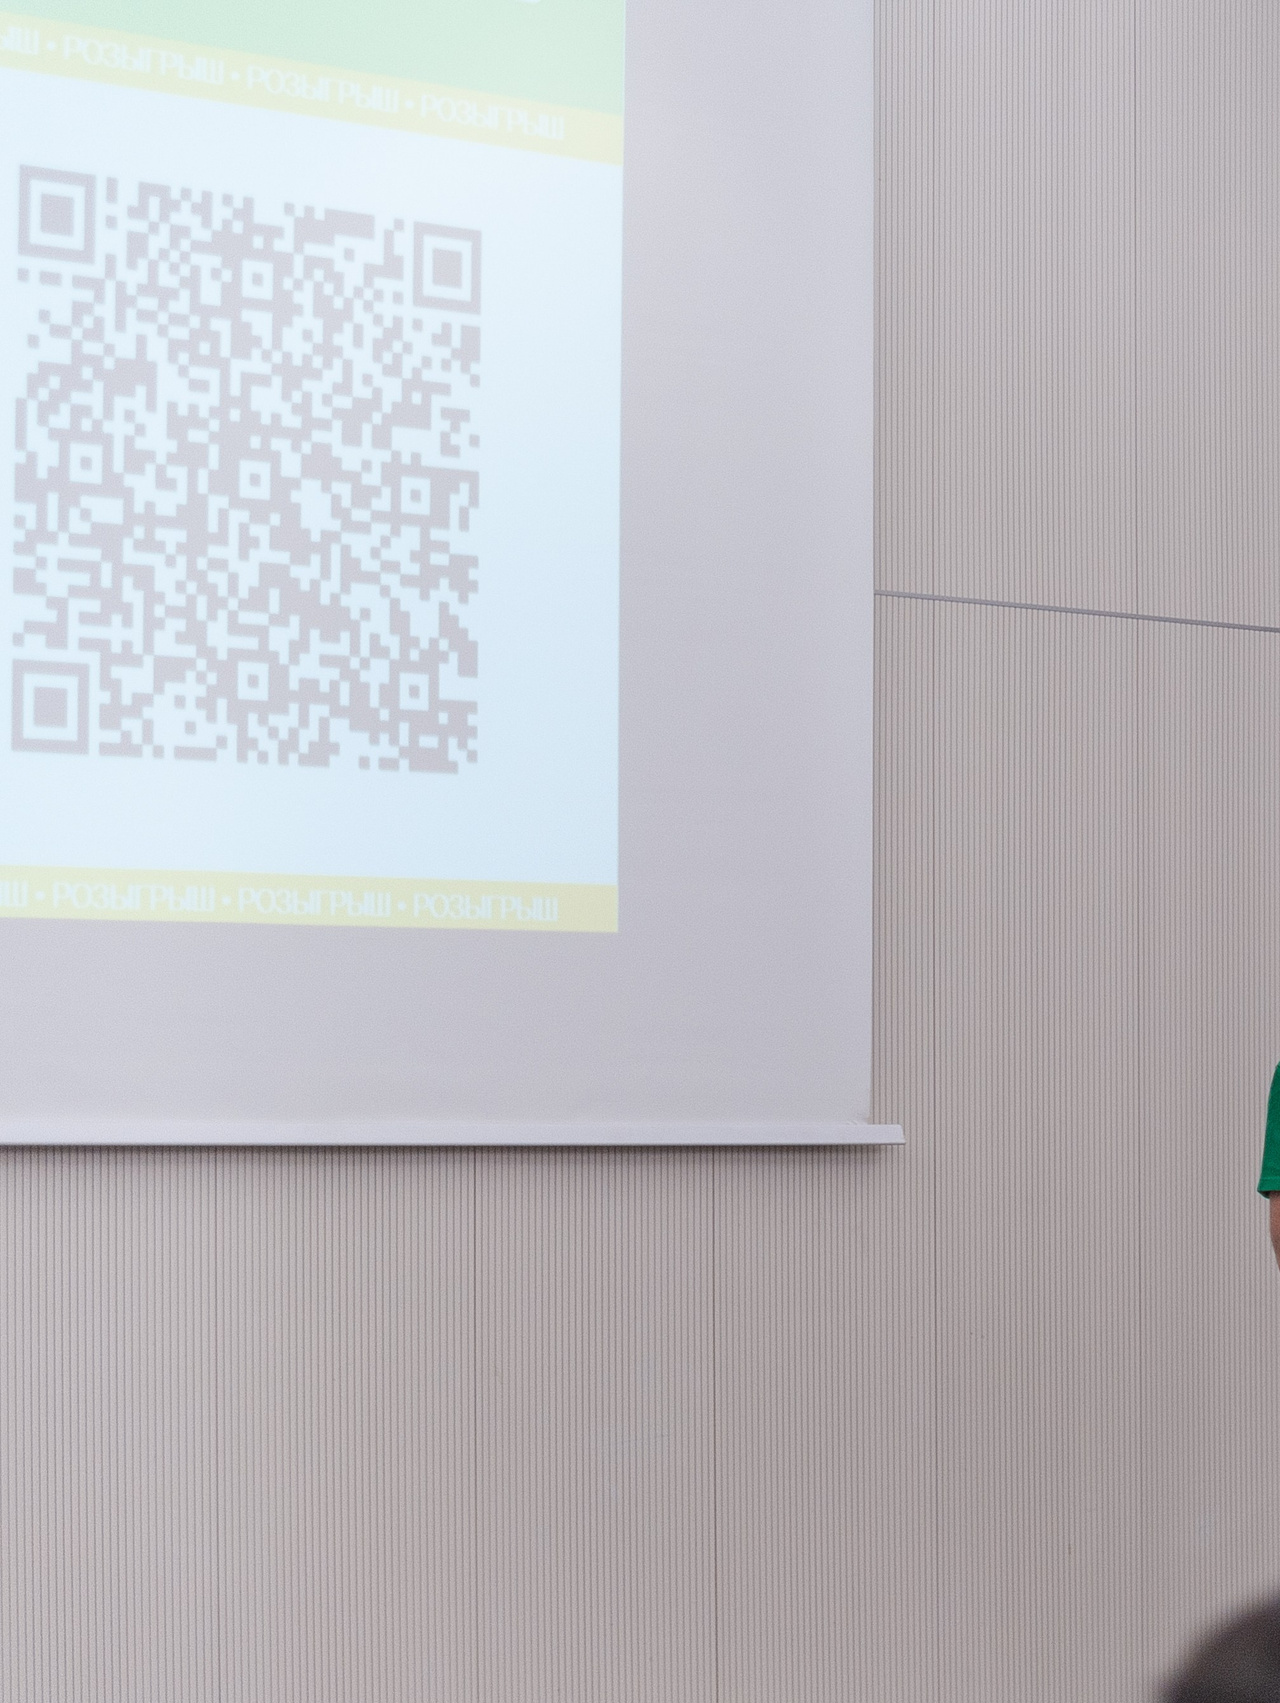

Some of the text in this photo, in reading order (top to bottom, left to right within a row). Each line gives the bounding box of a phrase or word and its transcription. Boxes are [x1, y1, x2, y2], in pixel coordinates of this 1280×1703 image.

[62, 34, 225, 85] РОЗЫГРЫШ
[247, 65, 400, 114] РОЗЫГРЫШ
[420, 94, 566, 141] РОЗЫГРЫШ
[53, 881, 216, 913] РОЗЫГРЫШ
[238, 887, 391, 918] РОЗЫГРЫШ
[413, 892, 559, 922] РОЗЫГРЫШ
